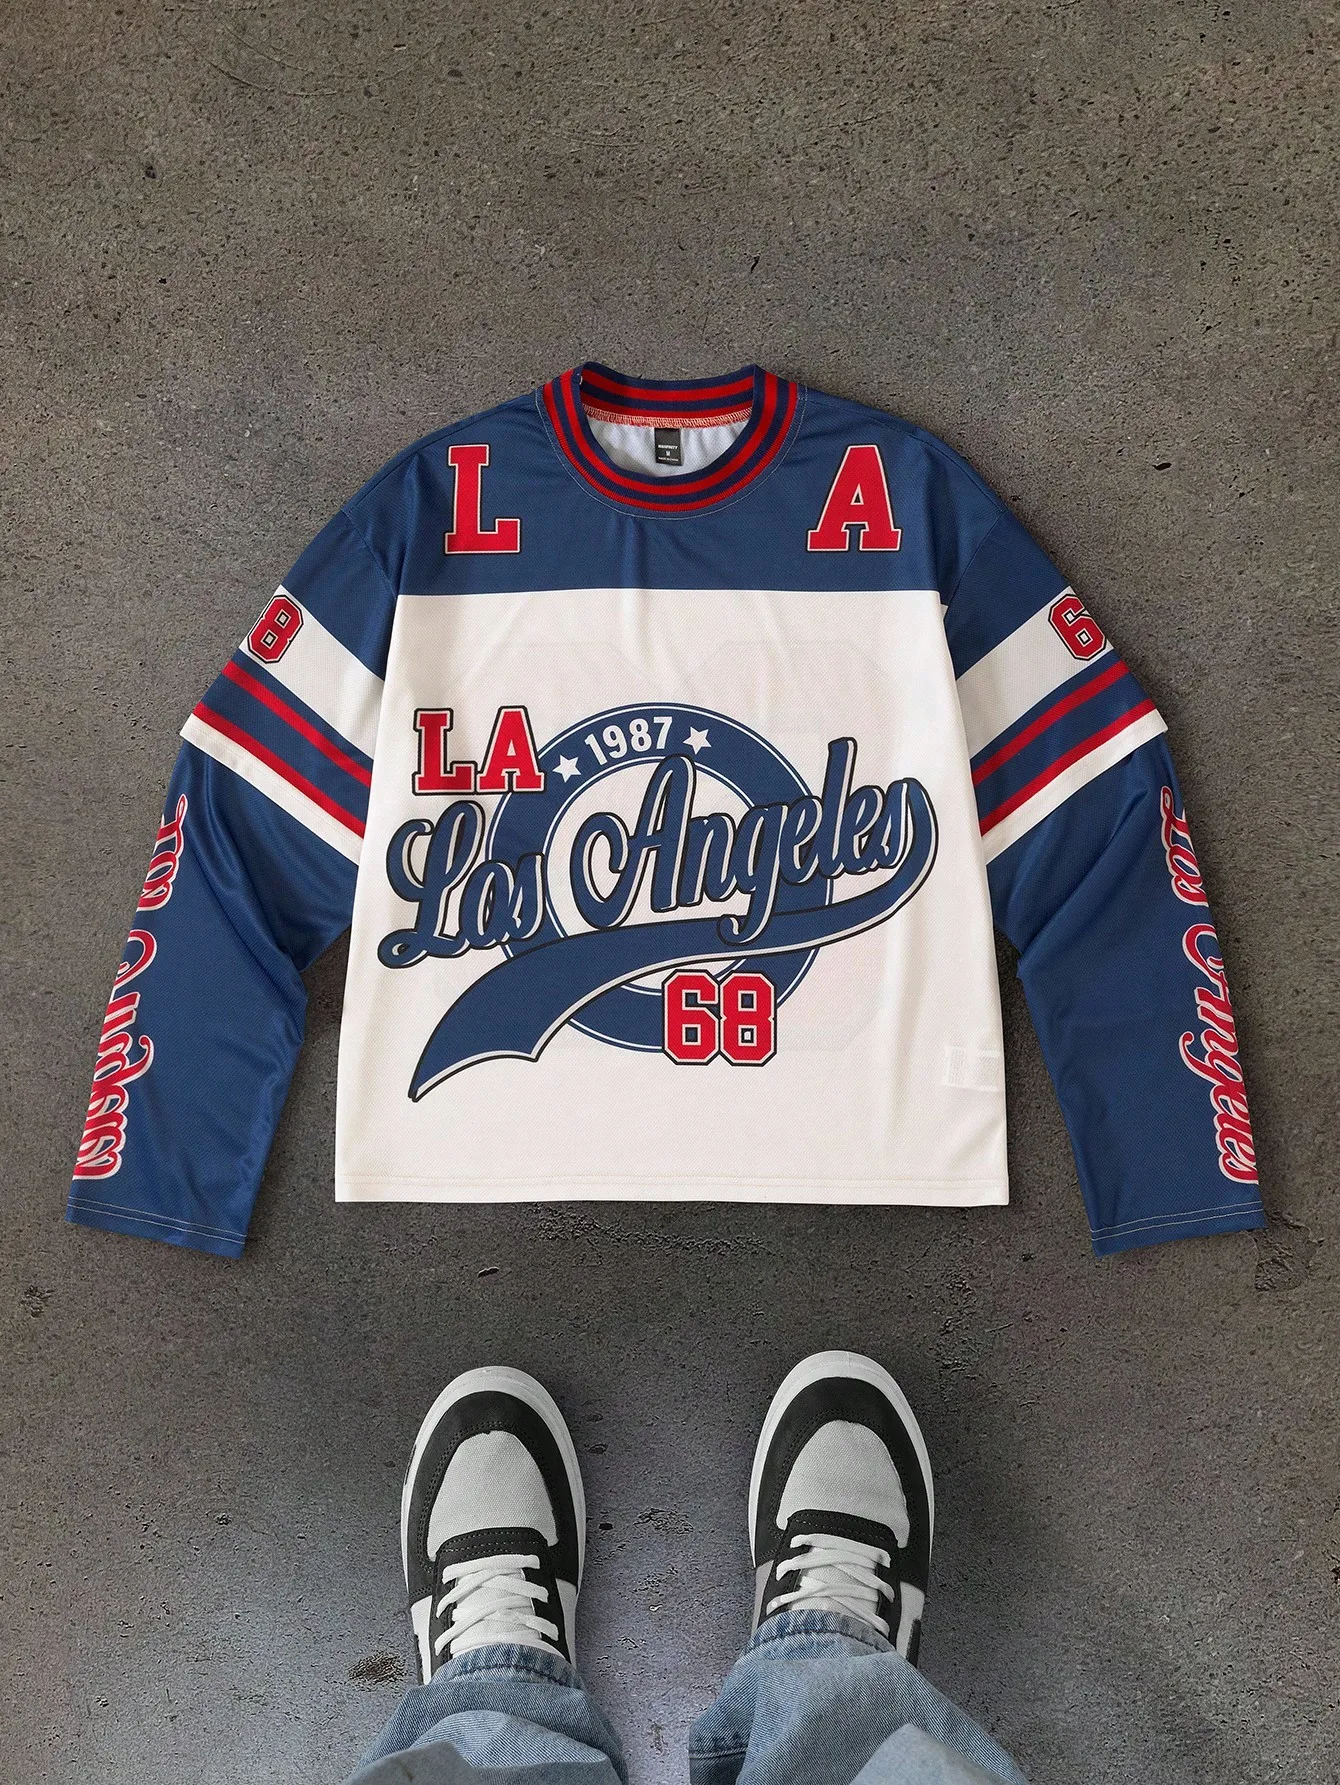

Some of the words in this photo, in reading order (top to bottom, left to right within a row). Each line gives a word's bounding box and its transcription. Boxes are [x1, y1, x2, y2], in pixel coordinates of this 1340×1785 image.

[444, 443, 522, 555] L
[806, 443, 903, 553] A
[247, 594, 304, 664] 8
[1048, 593, 1107, 661] 6
[412, 706, 545, 795] LA
[585, 716, 673, 765] 1987
[377, 800, 545, 968] Los
[570, 737, 938, 946] Angeles
[663, 969, 777, 1067] 68
